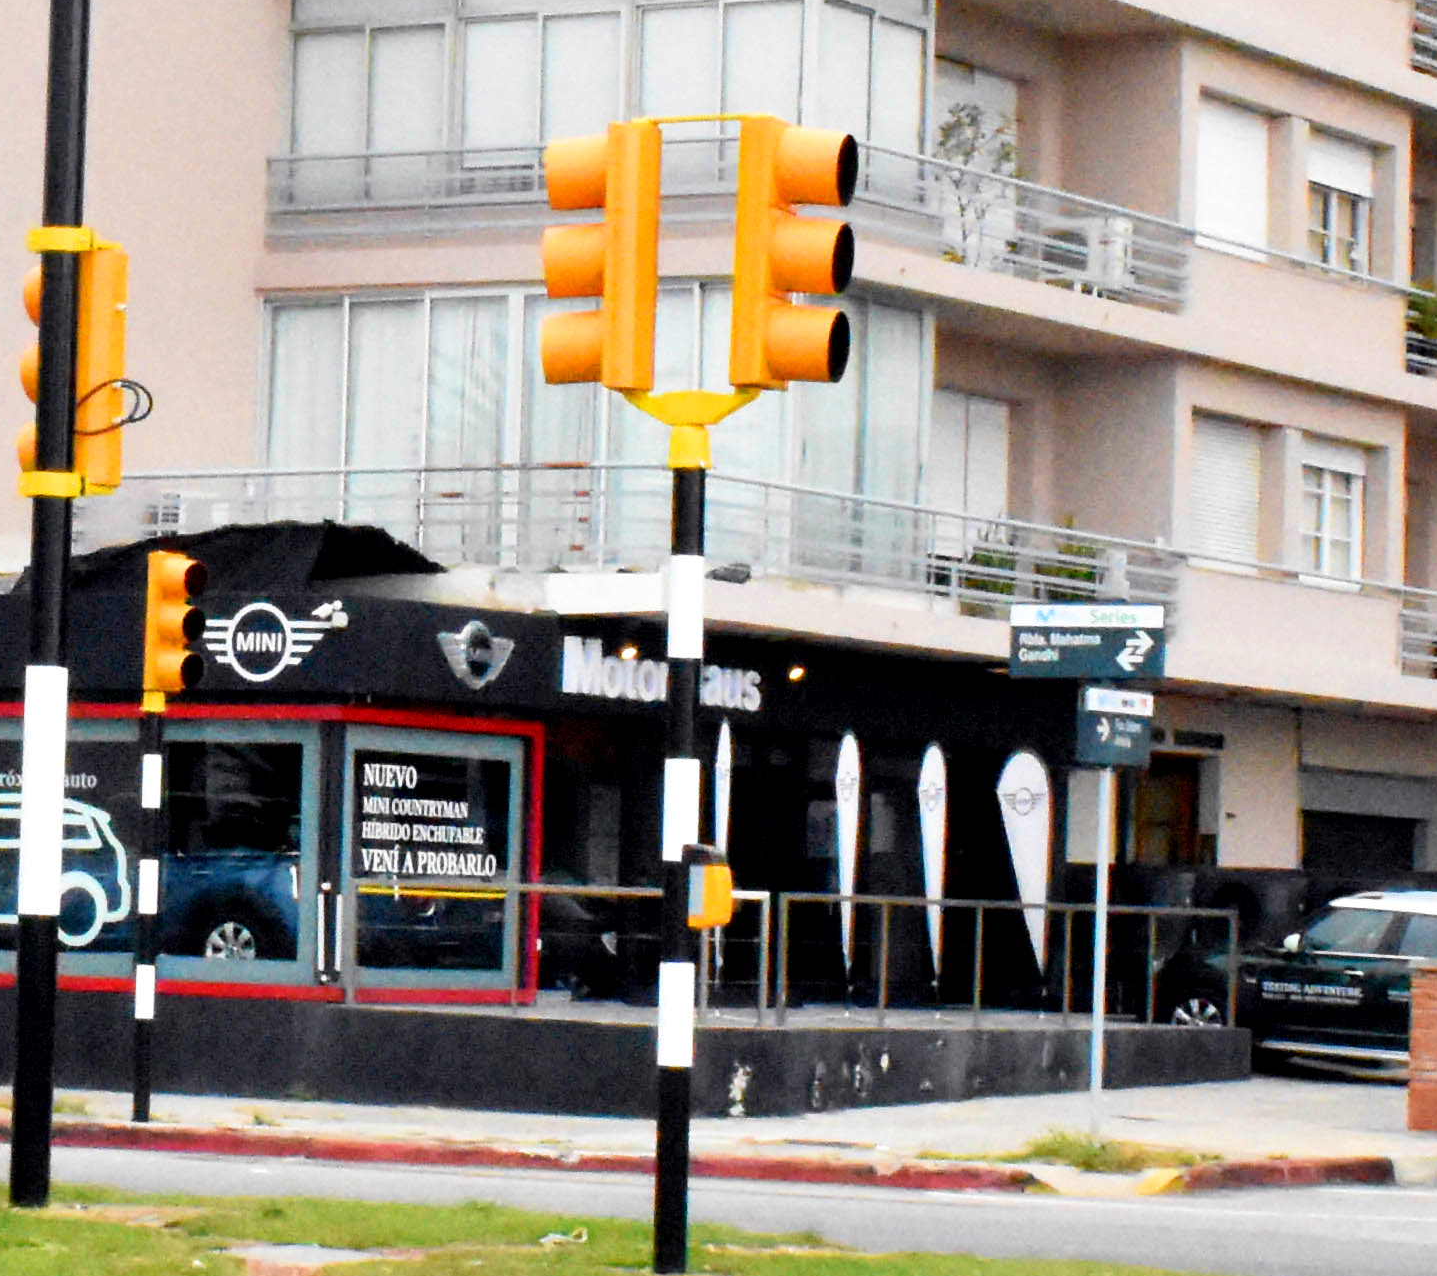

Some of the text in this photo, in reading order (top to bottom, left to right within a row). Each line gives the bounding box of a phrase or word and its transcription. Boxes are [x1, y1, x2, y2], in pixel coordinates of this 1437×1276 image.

[236, 631, 283, 653] MINI
[363, 763, 417, 789] NUEVO
[362, 796, 469, 819] MINI COUNTRYMAN
[412, 823, 484, 845] ENCHUFABLE
[402, 850, 414, 874] A
[417, 851, 497, 877] PROBARLO
